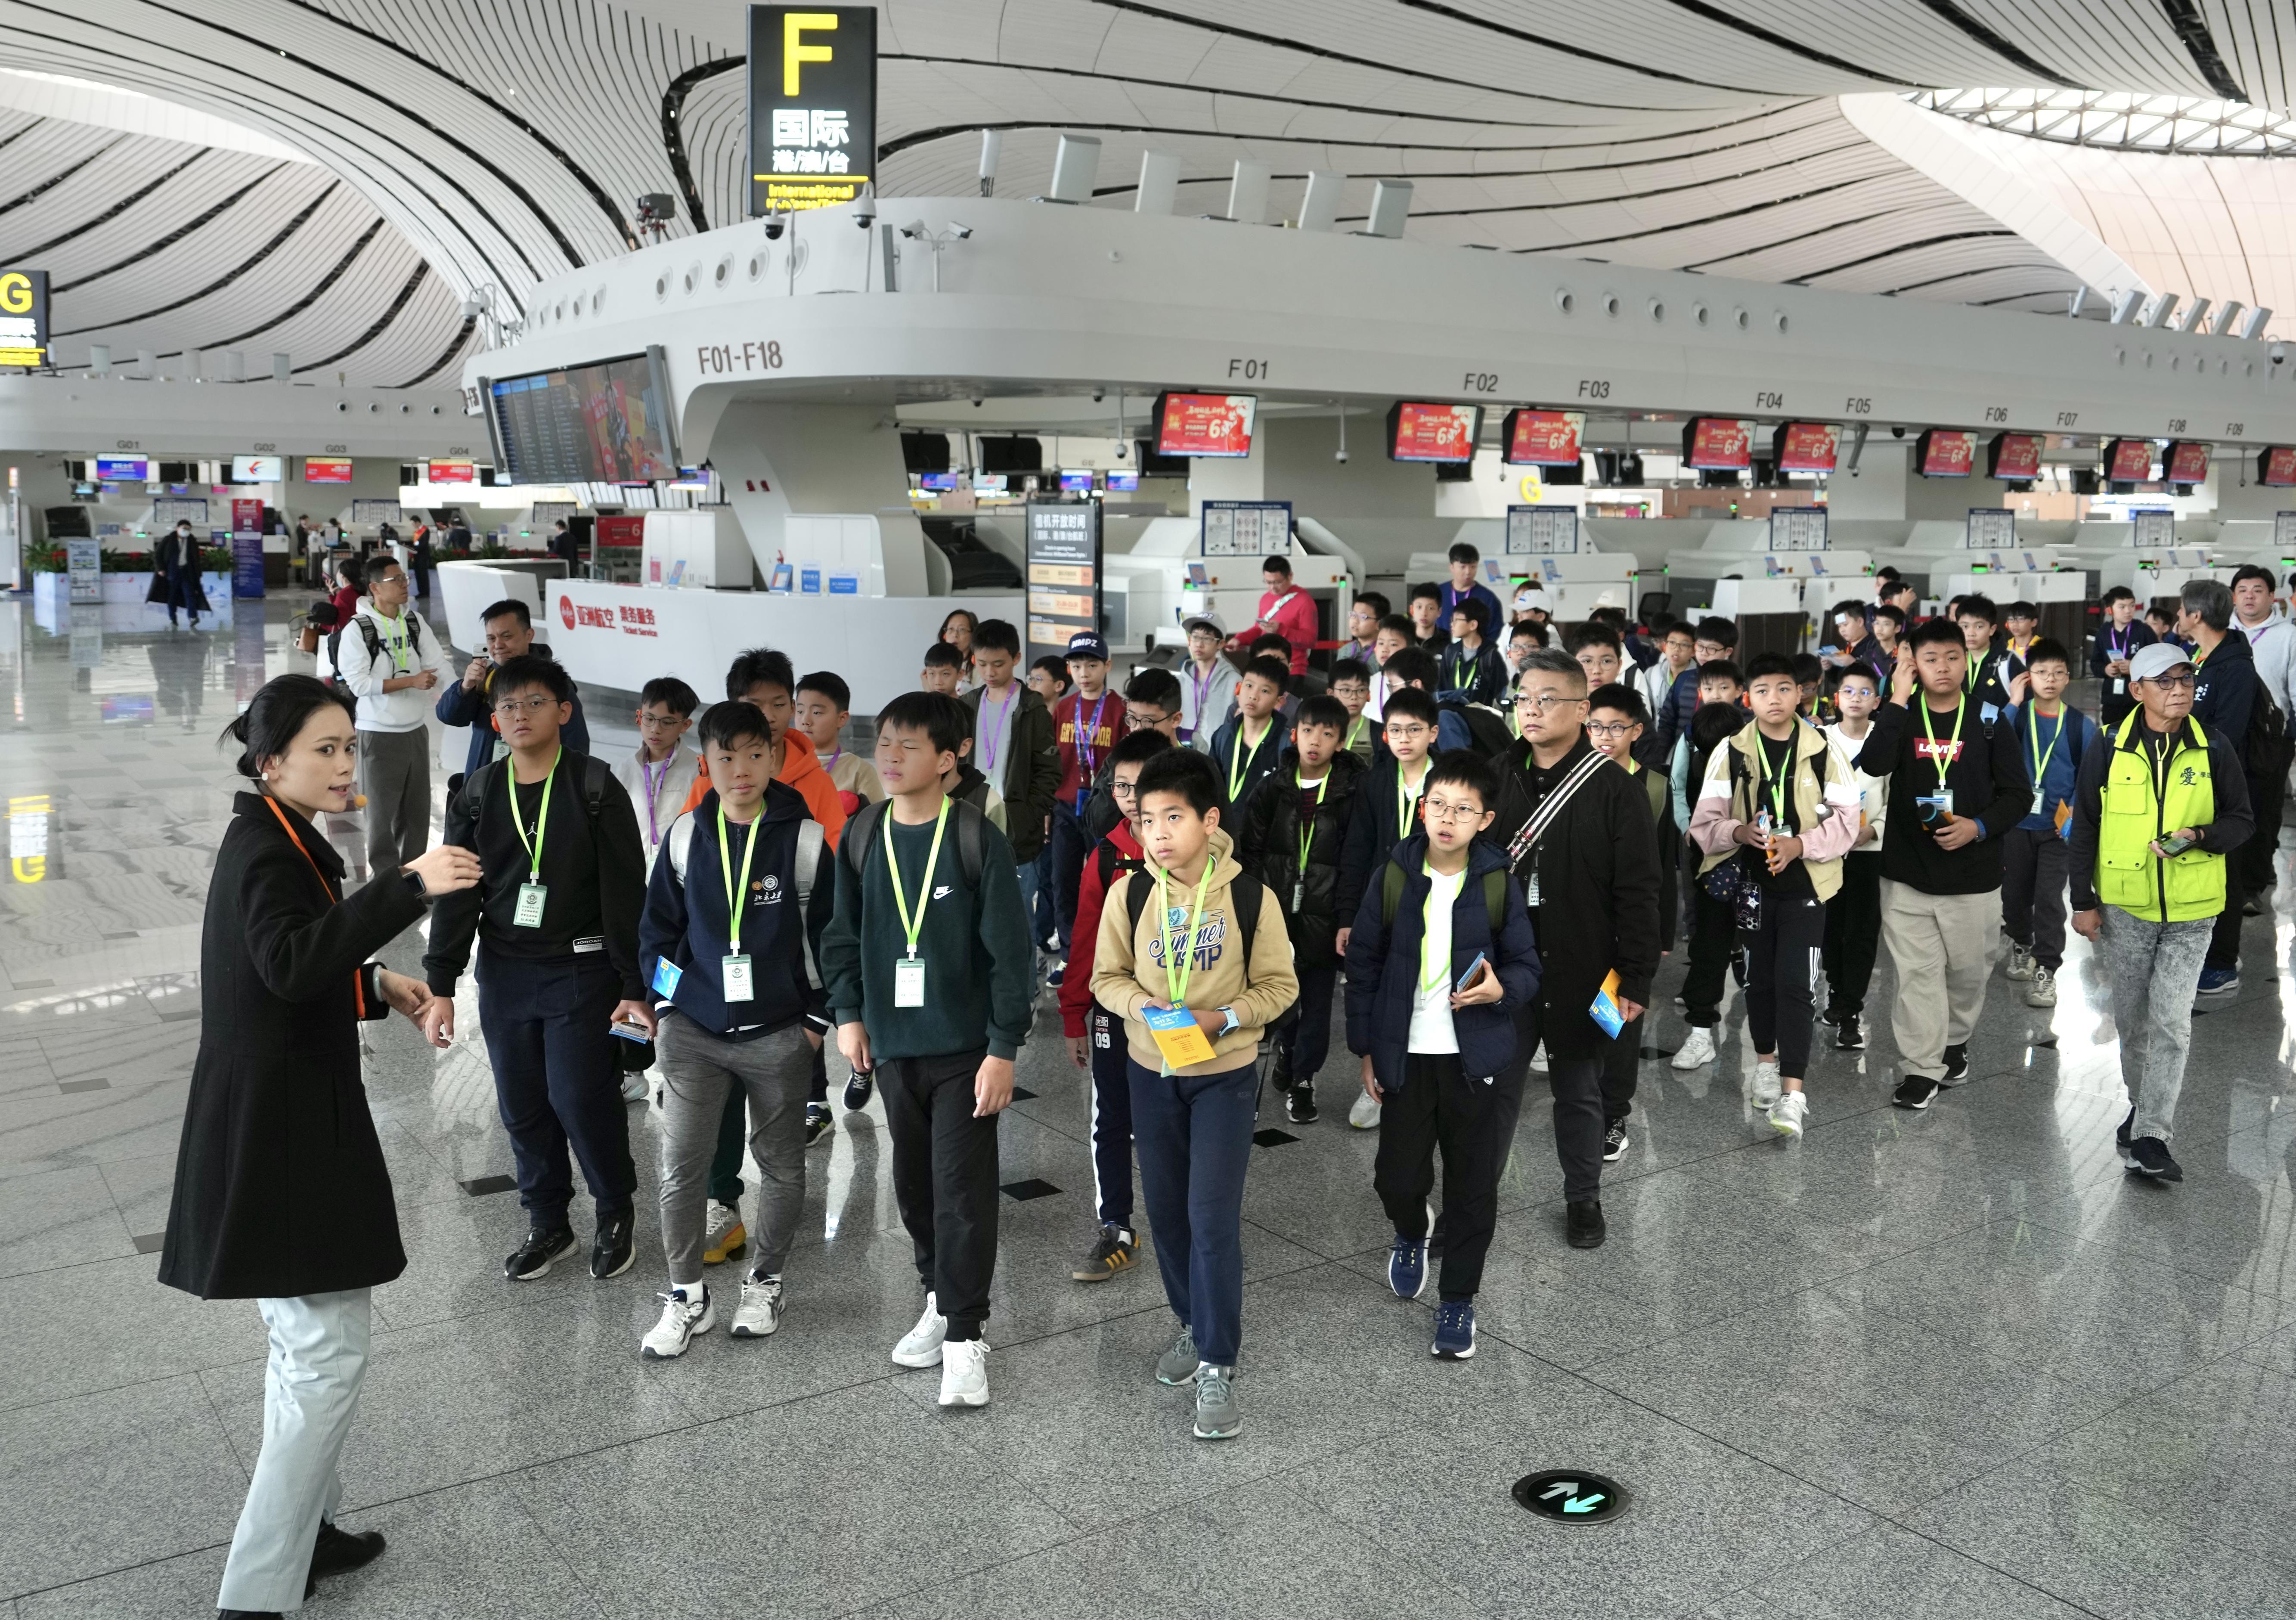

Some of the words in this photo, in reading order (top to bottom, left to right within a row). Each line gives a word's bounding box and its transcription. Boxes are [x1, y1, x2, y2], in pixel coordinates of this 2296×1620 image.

[784, 13, 838, 96] F
[773, 109, 850, 147] 国际
[768, 184, 854, 198] International
[0, 273, 33, 313] G
[697, 340, 783, 374] F01-F18
[1228, 359, 1268, 380] F01
[1464, 373, 1499, 392] F02
[1577, 380, 1610, 398] F03
[1756, 392, 1783, 409] F04
[1846, 397, 1872, 413] F05
[1985, 406, 2008, 422] F06
[2056, 412, 2078, 426] F07
[2167, 418, 2187, 432] F08
[116, 440, 139, 449] G01
[254, 442, 276, 452] G02
[325, 444, 347, 454] G03
[449, 446, 469, 455] G04
[1520, 475, 1543, 503] G
[1035, 513, 1086, 529] 值机开放时间
[576, 604, 617, 629] 亚洲航空
[618, 605, 656, 626] 票务服务
[622, 626, 638, 635] Ticket
[638, 628, 658, 638] Service
[1071, 637, 1098, 649] NMPZ
[2179, 766, 2197, 786] 愛
[1095, 1032, 1111, 1049] 09
